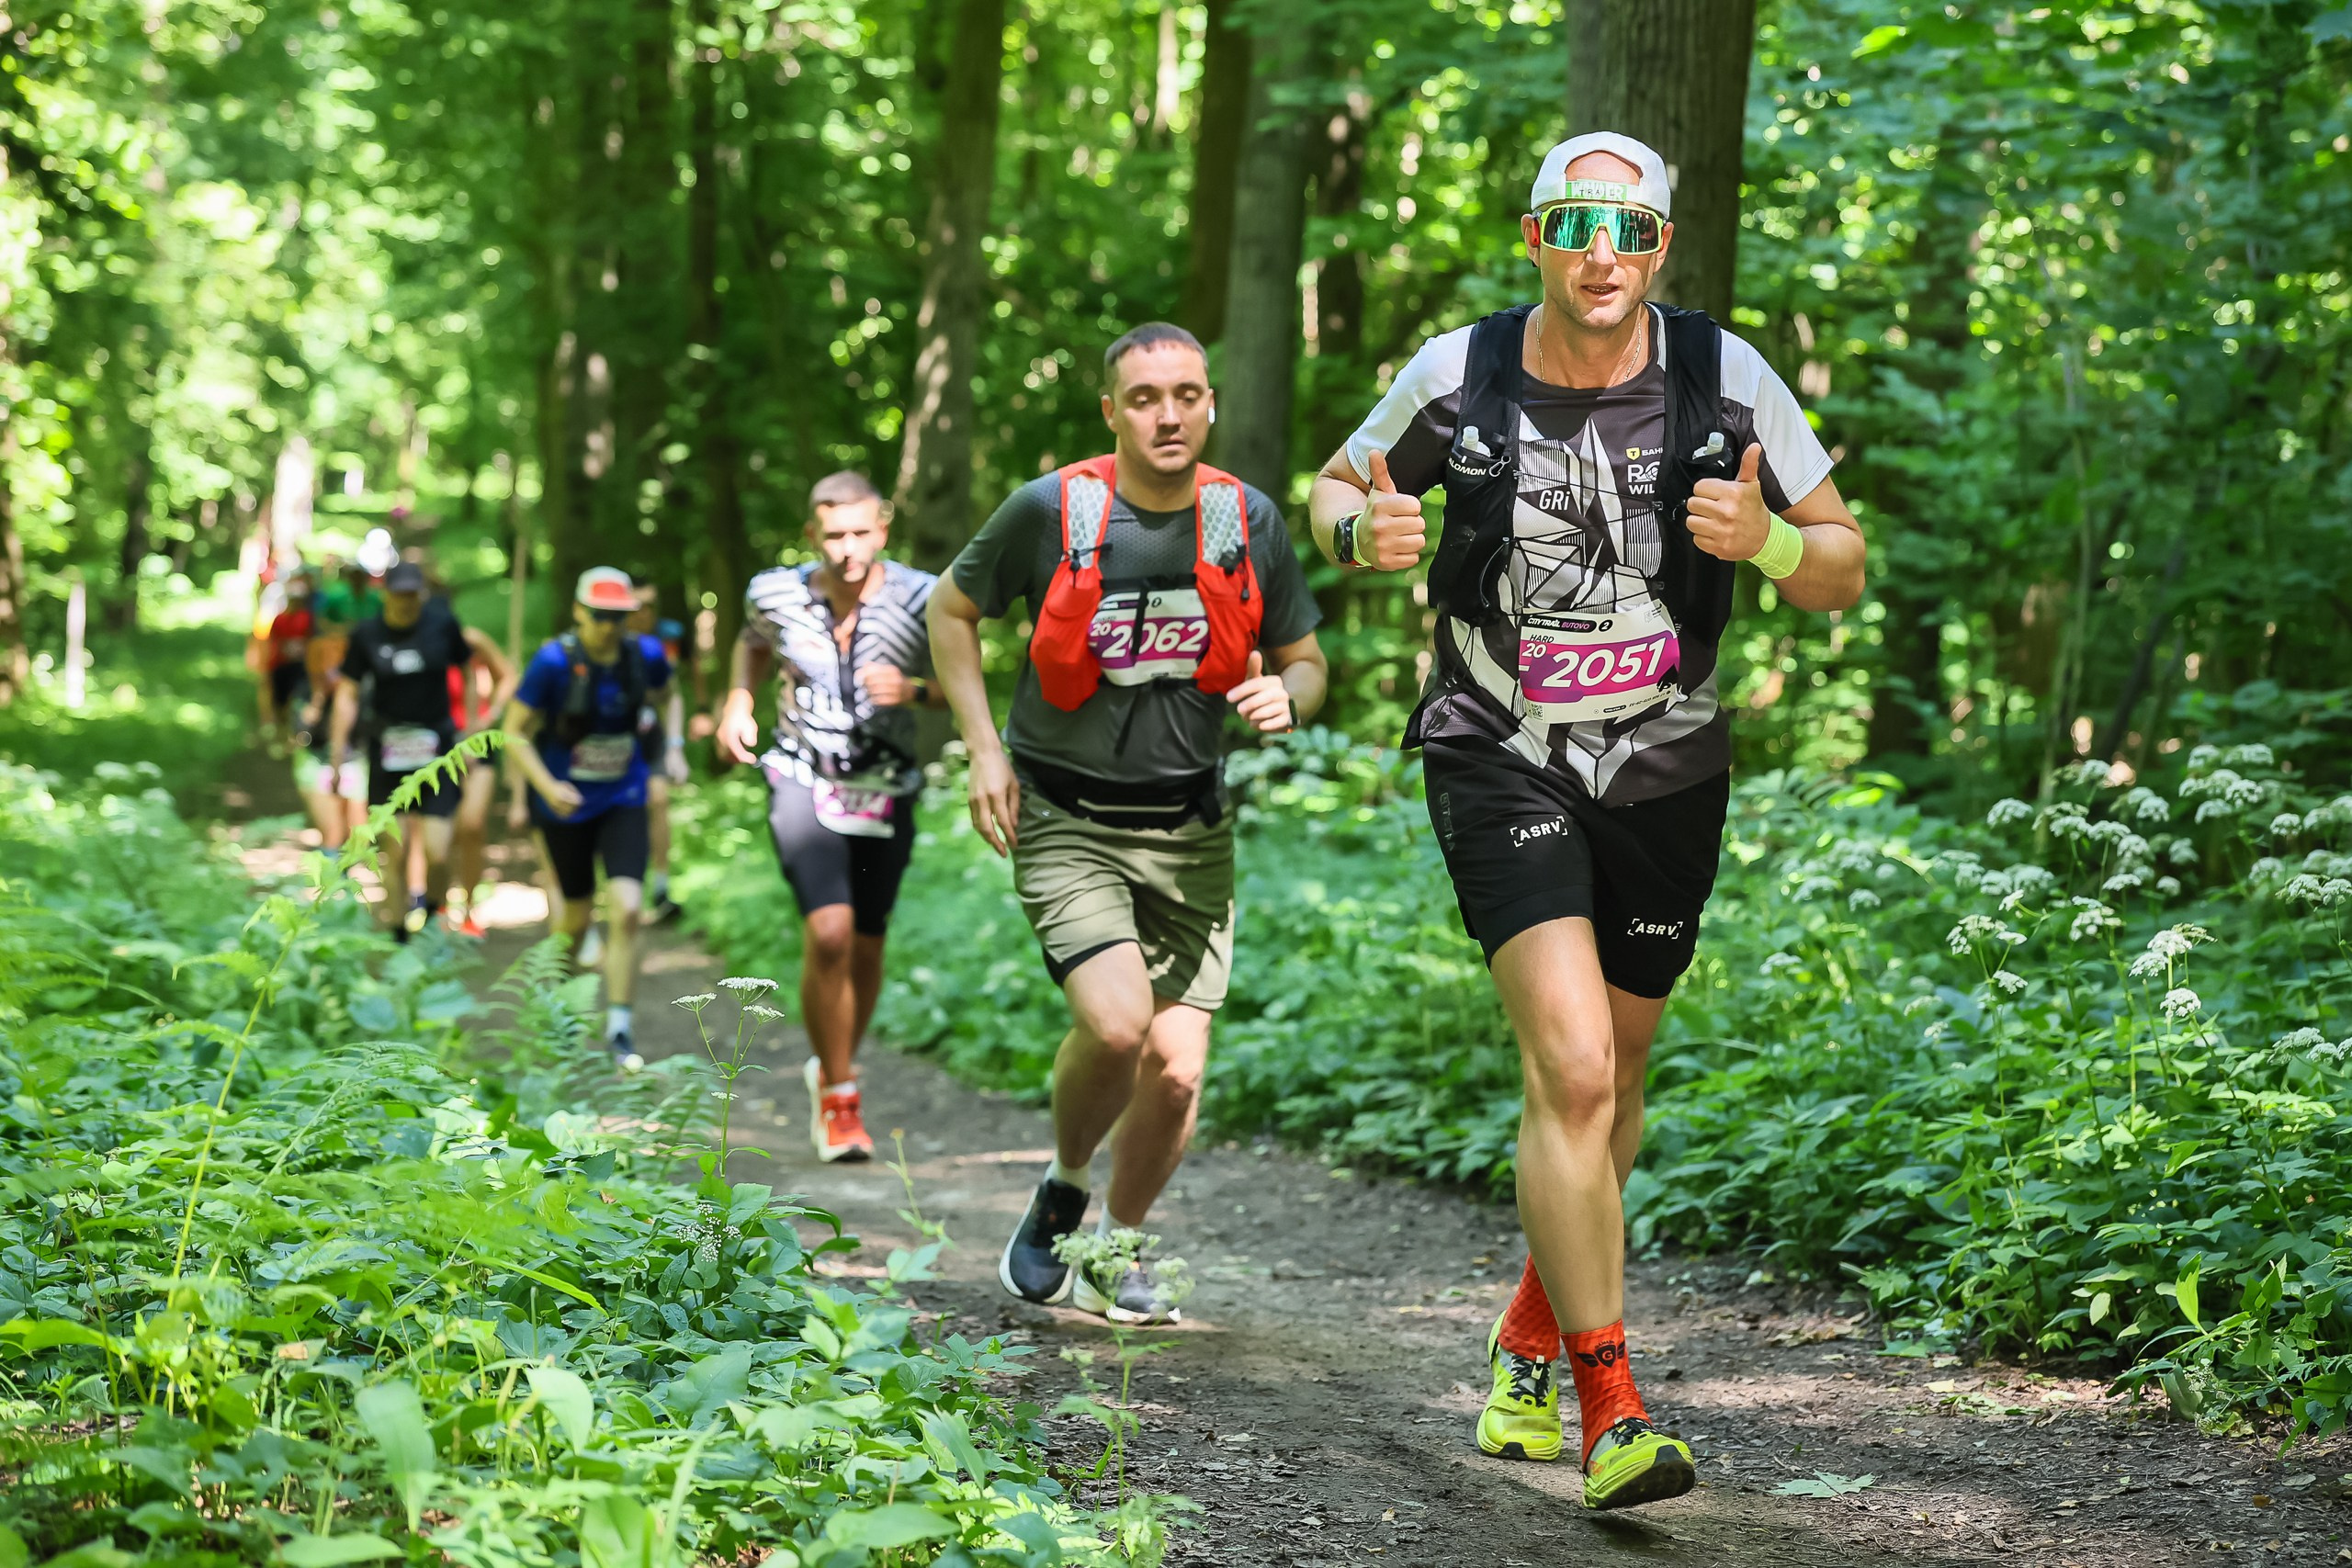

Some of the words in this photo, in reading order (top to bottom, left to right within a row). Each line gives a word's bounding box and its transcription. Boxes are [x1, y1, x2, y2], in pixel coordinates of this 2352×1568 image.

[1448, 457, 1487, 476] ALOMON
[1628, 483, 1656, 495] WIL
[1090, 622, 1113, 637] 20
[1561, 621, 1590, 630] BUTOVO
[1601, 621, 1610, 630] 2
[1530, 634, 1555, 643] HARD
[1521, 642, 1547, 659] 20
[1541, 637, 1667, 688] 2051
[1520, 820, 1560, 841] ASRV
[1634, 922, 1678, 936] ASRV
[1601, 1349, 1613, 1361] G
